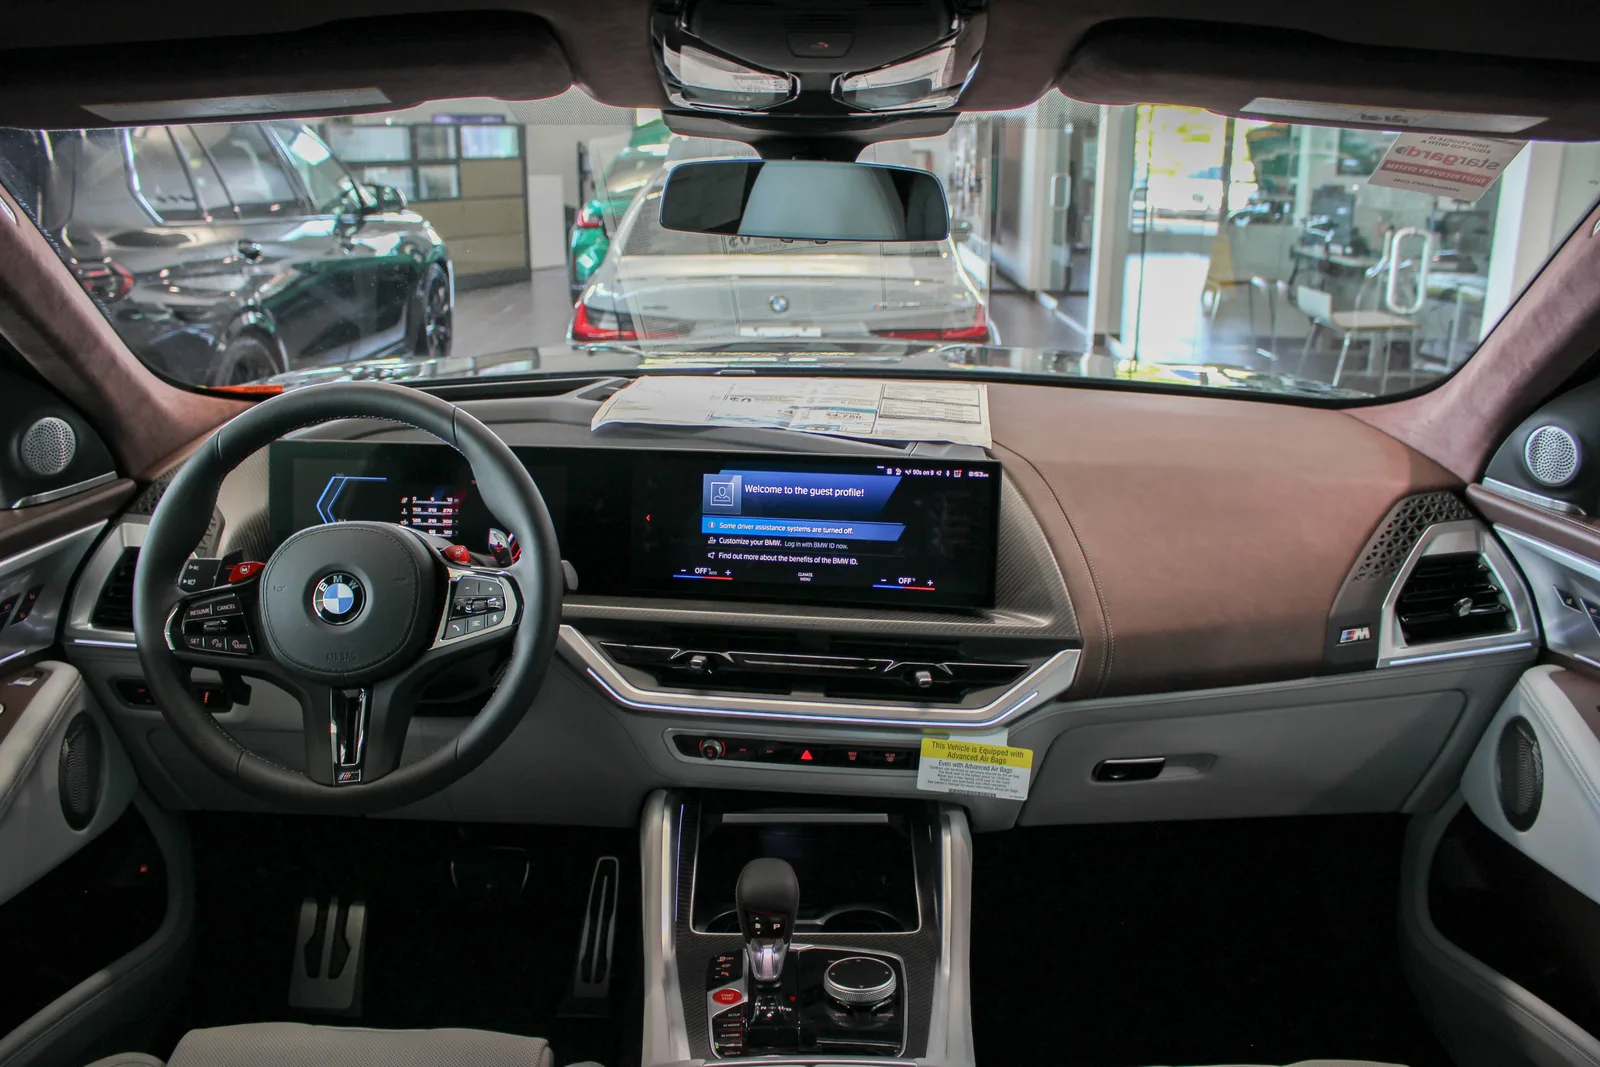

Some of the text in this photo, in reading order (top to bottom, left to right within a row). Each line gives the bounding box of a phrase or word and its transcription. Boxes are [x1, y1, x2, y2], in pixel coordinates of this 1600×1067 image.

[745, 484, 864, 498] Welcome to the guest profile!
[755, 524, 786, 532] assistance
[843, 527, 854, 535] off.
[719, 537, 749, 545] Customize
[764, 539, 782, 547] BMW.
[718, 552, 732, 560] Find
[760, 554, 777, 562] about
[789, 555, 813, 564] benefits
[814, 556, 821, 564] of
[319, 575, 359, 592] BMW
[190, 608, 210, 616] RESUME
[932, 741, 946, 750] This
[947, 743, 970, 752] Vehicle
[978, 747, 1009, 757] Equipped
[1010, 751, 1024, 759] with
[947, 751, 1007, 765] Advanced Air Bags
[964, 763, 990, 772] Advanced
[1000, 766, 1013, 774] Bags
